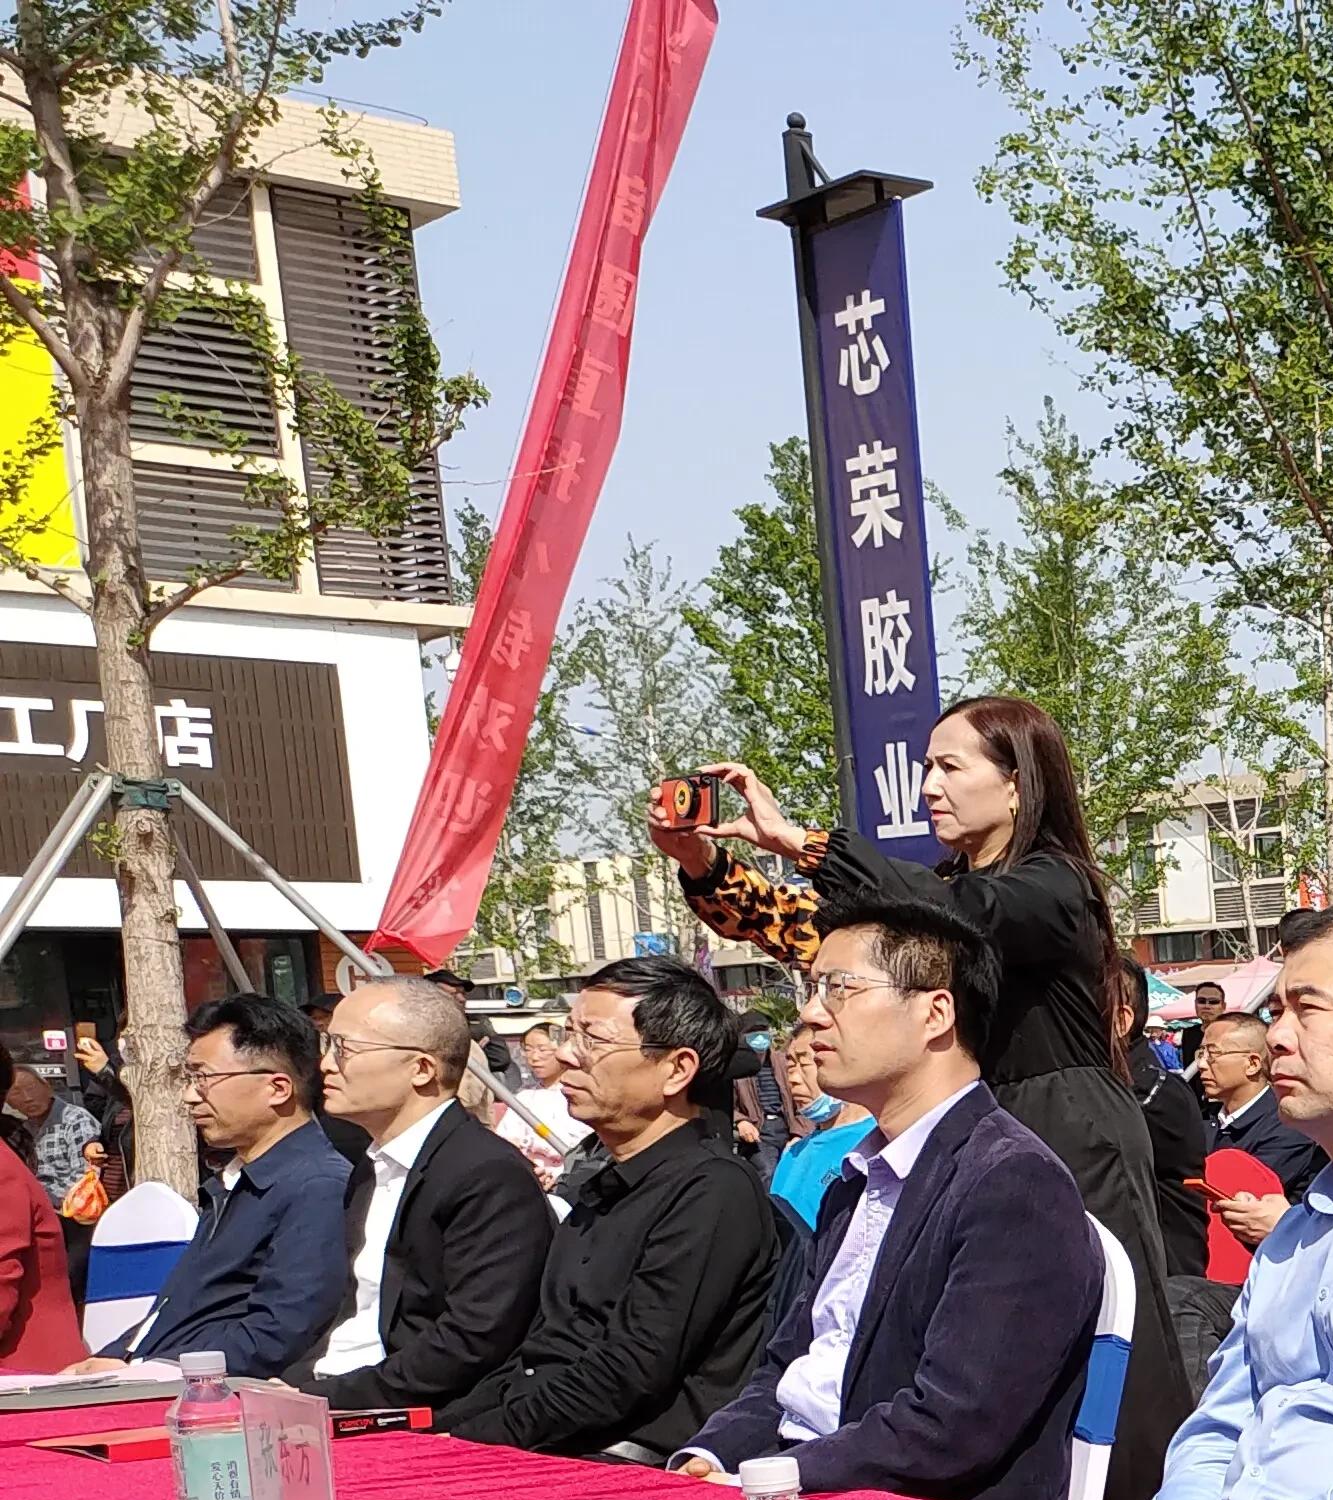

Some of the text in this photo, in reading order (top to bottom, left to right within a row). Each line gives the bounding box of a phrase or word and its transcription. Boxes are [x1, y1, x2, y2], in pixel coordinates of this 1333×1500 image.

[834, 289, 932, 840] 芯荣胶业
[211, 1462, 225, 1500] 爱心无价
